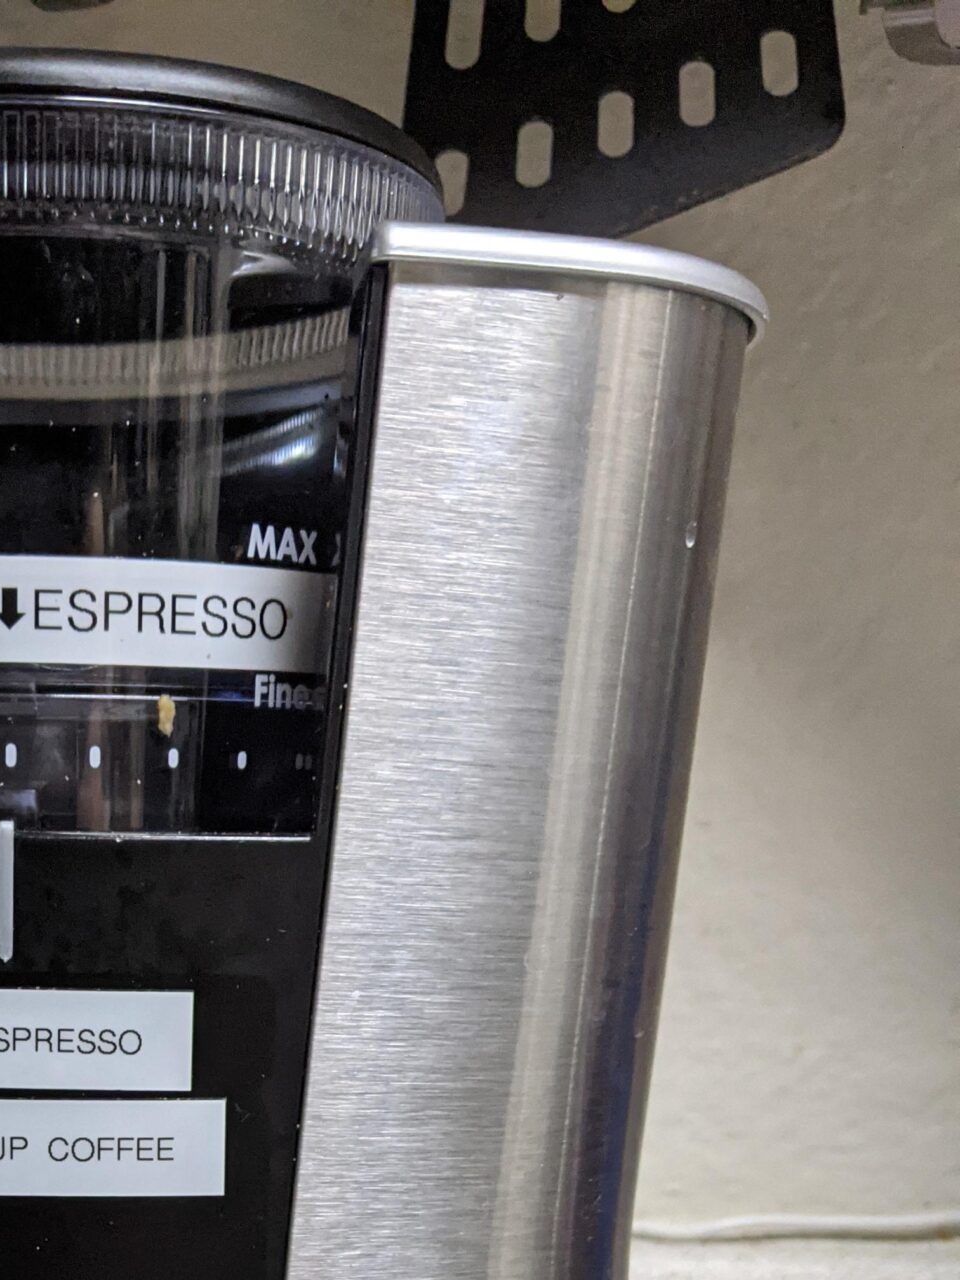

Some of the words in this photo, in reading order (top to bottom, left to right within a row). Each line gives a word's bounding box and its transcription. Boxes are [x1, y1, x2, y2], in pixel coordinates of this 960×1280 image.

[247, 523, 318, 566] MAX
[33, 588, 288, 641] ESPRESSO
[47, 1136, 175, 1163] COFFEE
